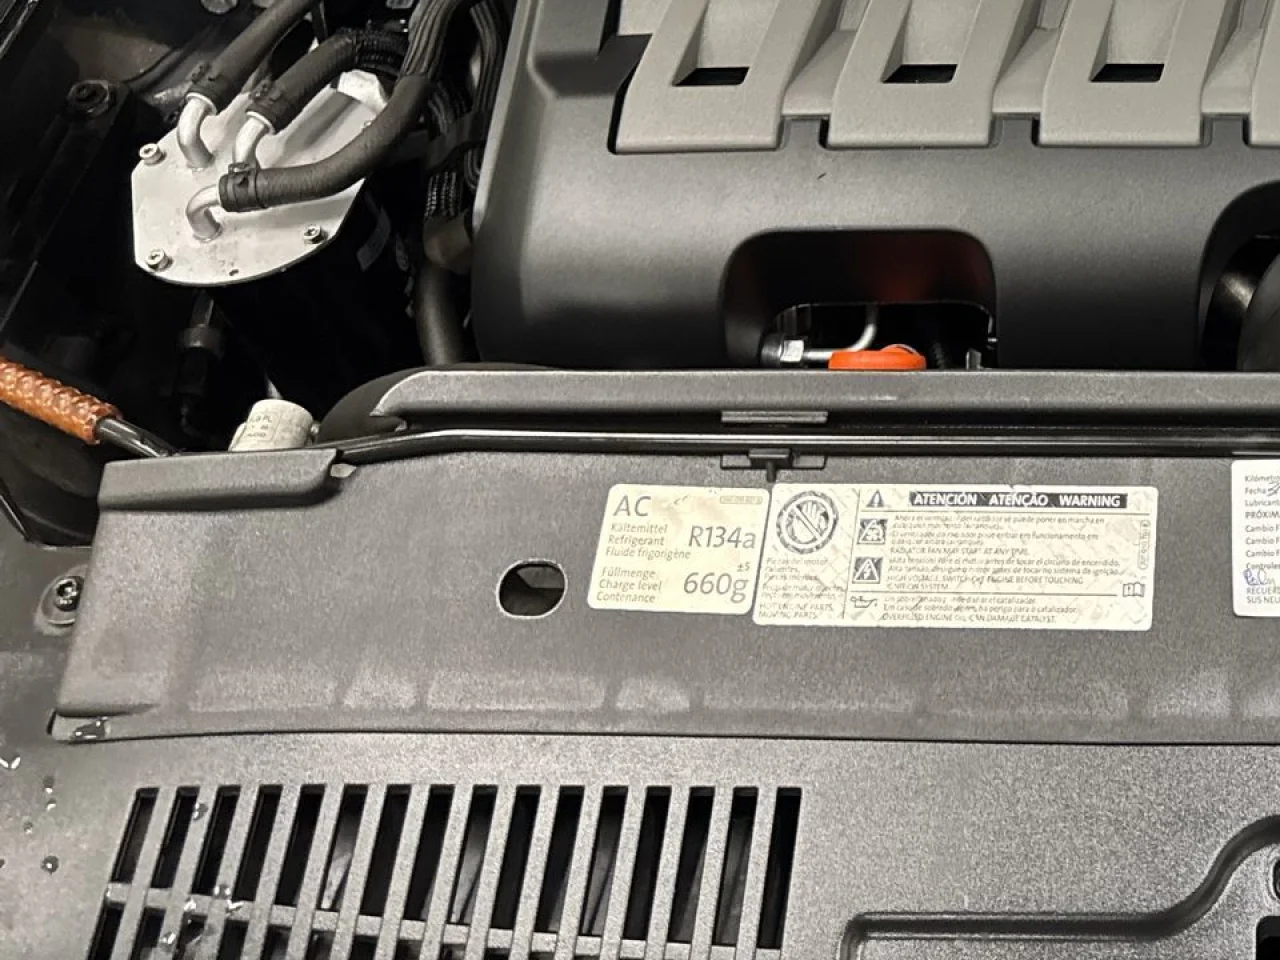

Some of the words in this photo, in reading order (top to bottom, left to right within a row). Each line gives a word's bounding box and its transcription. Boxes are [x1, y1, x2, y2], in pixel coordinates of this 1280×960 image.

[1245, 487, 1266, 495] Fecha
[914, 492, 977, 505] ATENCIÓN
[989, 493, 1049, 507] ATENÇÃO
[1059, 495, 1121, 508] WARNING
[613, 496, 651, 517] AC
[610, 523, 668, 534] Kältemittel
[1245, 524, 1274, 532] Cambio
[608, 534, 664, 546] Refrigerant
[688, 526, 757, 549] R134a
[1245, 536, 1274, 544] Cambio
[605, 546, 635, 557] Fluide
[637, 548, 691, 561] frigorigène
[1245, 549, 1274, 557] Cambio
[602, 567, 656, 579] Füllmenge
[599, 579, 635, 591] Charge
[637, 581, 662, 591] level
[683, 572, 749, 604] 660g
[596, 592, 656, 603] Contenance
[1246, 595, 1262, 604] SUS
